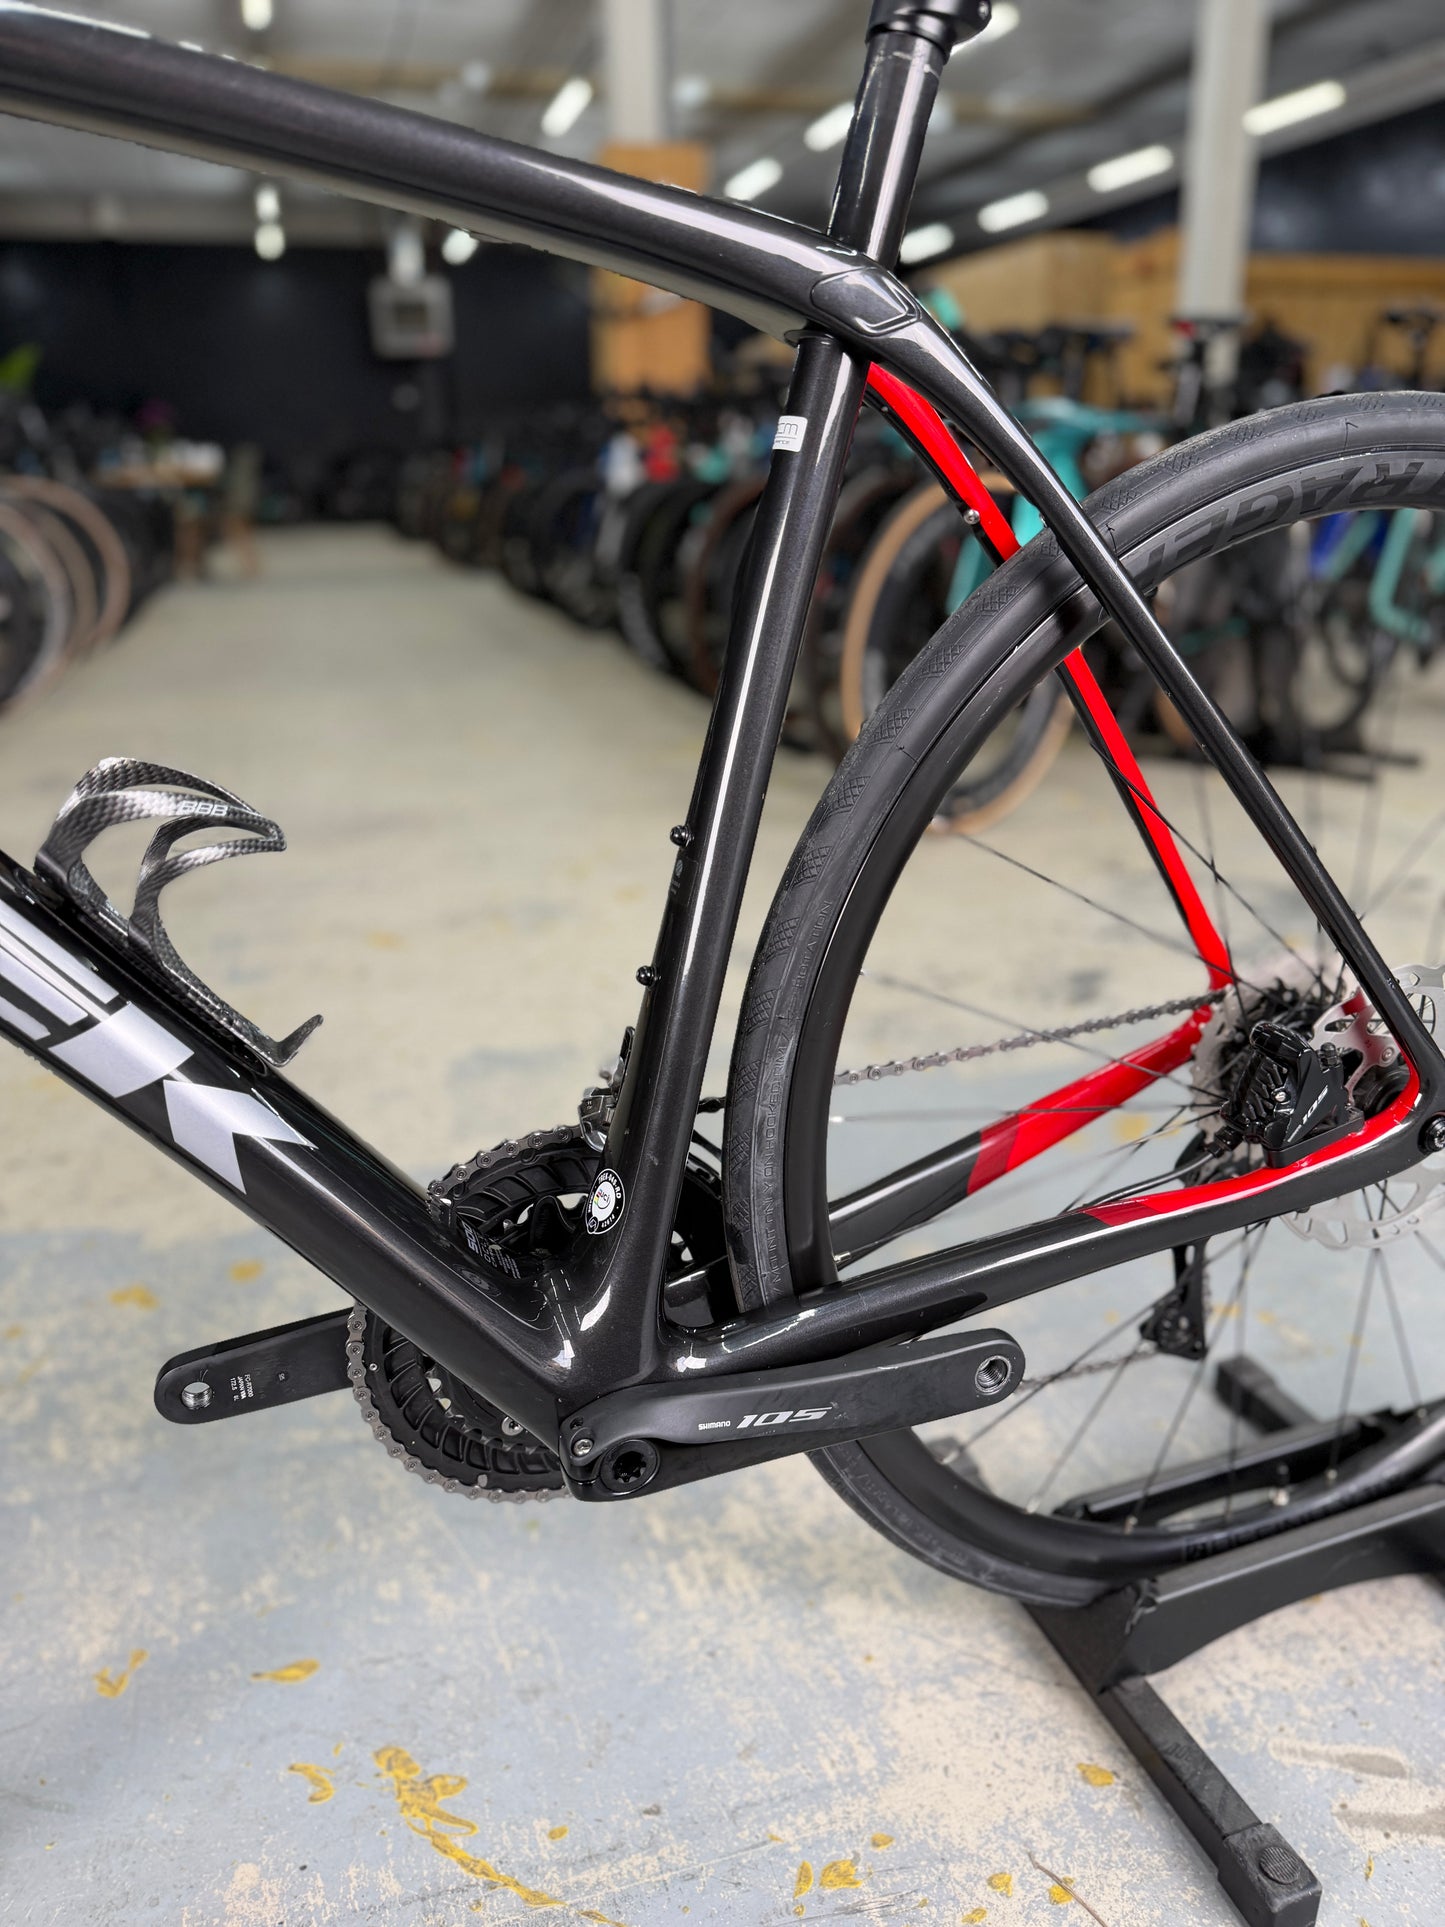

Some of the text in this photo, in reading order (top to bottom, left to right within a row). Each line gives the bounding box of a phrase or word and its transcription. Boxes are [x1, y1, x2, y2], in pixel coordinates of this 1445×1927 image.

[179, 800, 228, 817] BBB
[765, 1079, 782, 1151] HOOKED
[698, 1406, 833, 1431] SHIMANO 105
